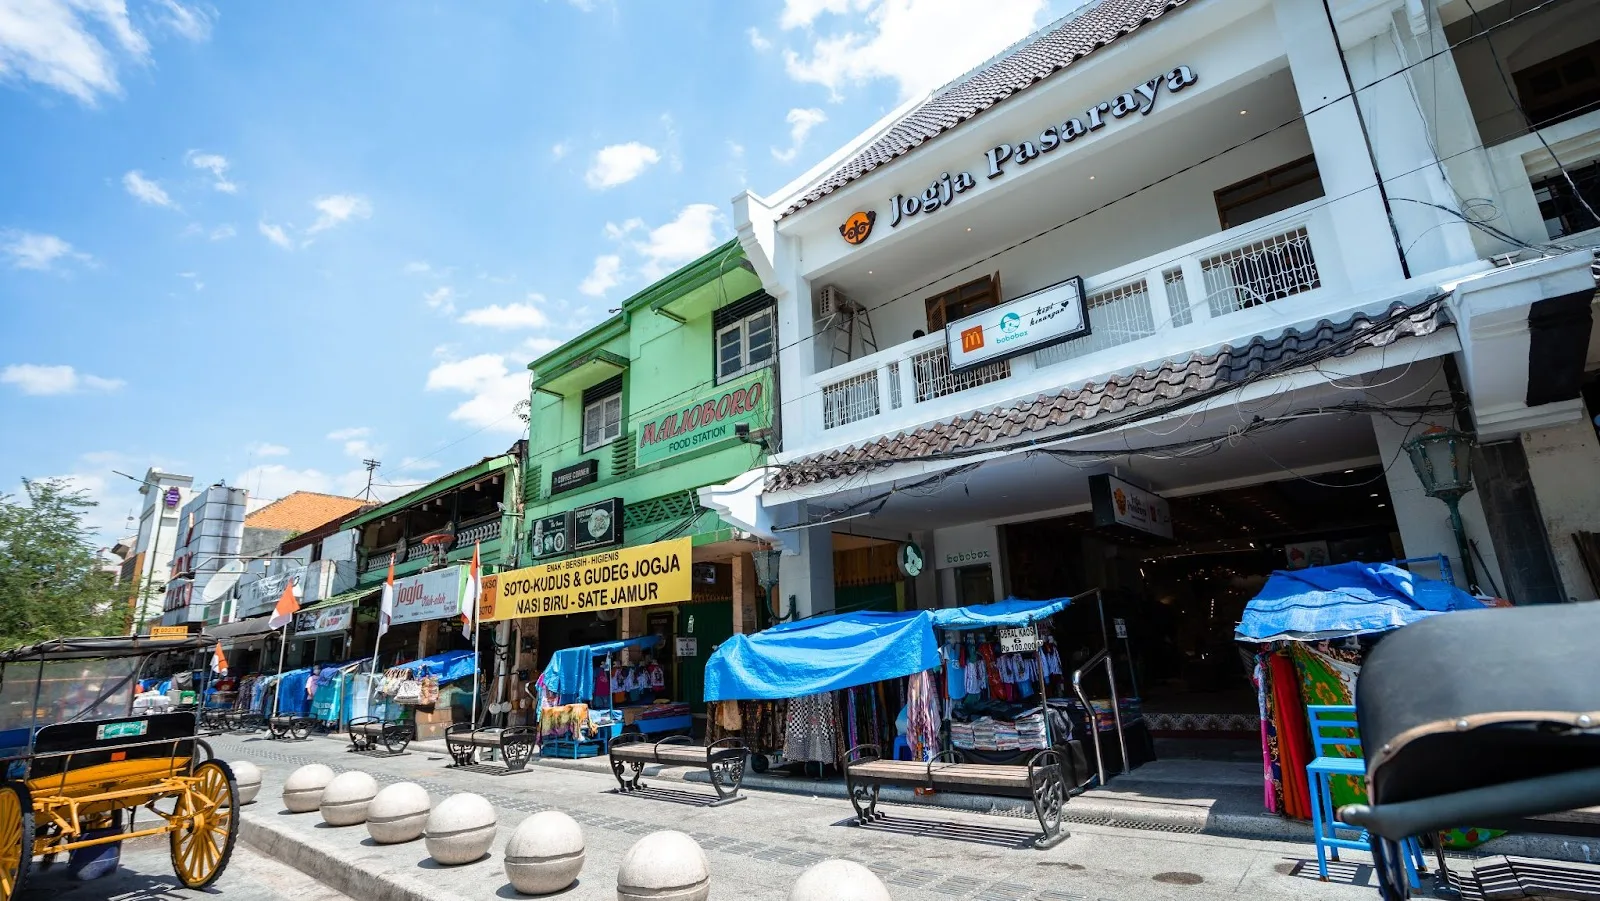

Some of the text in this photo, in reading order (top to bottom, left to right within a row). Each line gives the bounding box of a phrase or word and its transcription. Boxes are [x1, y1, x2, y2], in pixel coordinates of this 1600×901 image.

[888, 64, 1199, 228] Jogja Pasaraya
[996, 330, 1029, 345] bobobox
[640, 382, 762, 448] MALIOBORO
[668, 425, 727, 453] FOOD STATION
[546, 563, 562, 573] ENAK
[565, 558, 587, 570] BERSIH
[591, 552, 619, 565] HIGIENIS
[946, 550, 989, 563] bobobox
[504, 554, 680, 597] SOTO-KUDUS & GUDEG JOGJA
[484, 593, 488, 602] &
[516, 599, 540, 615] NASI
[543, 595, 569, 612] BIRU
[577, 589, 607, 609] SATE
[611, 582, 658, 605] JAMUR
[1019, 626, 1034, 638] KAOS
[1001, 644, 1010, 652] Rp
